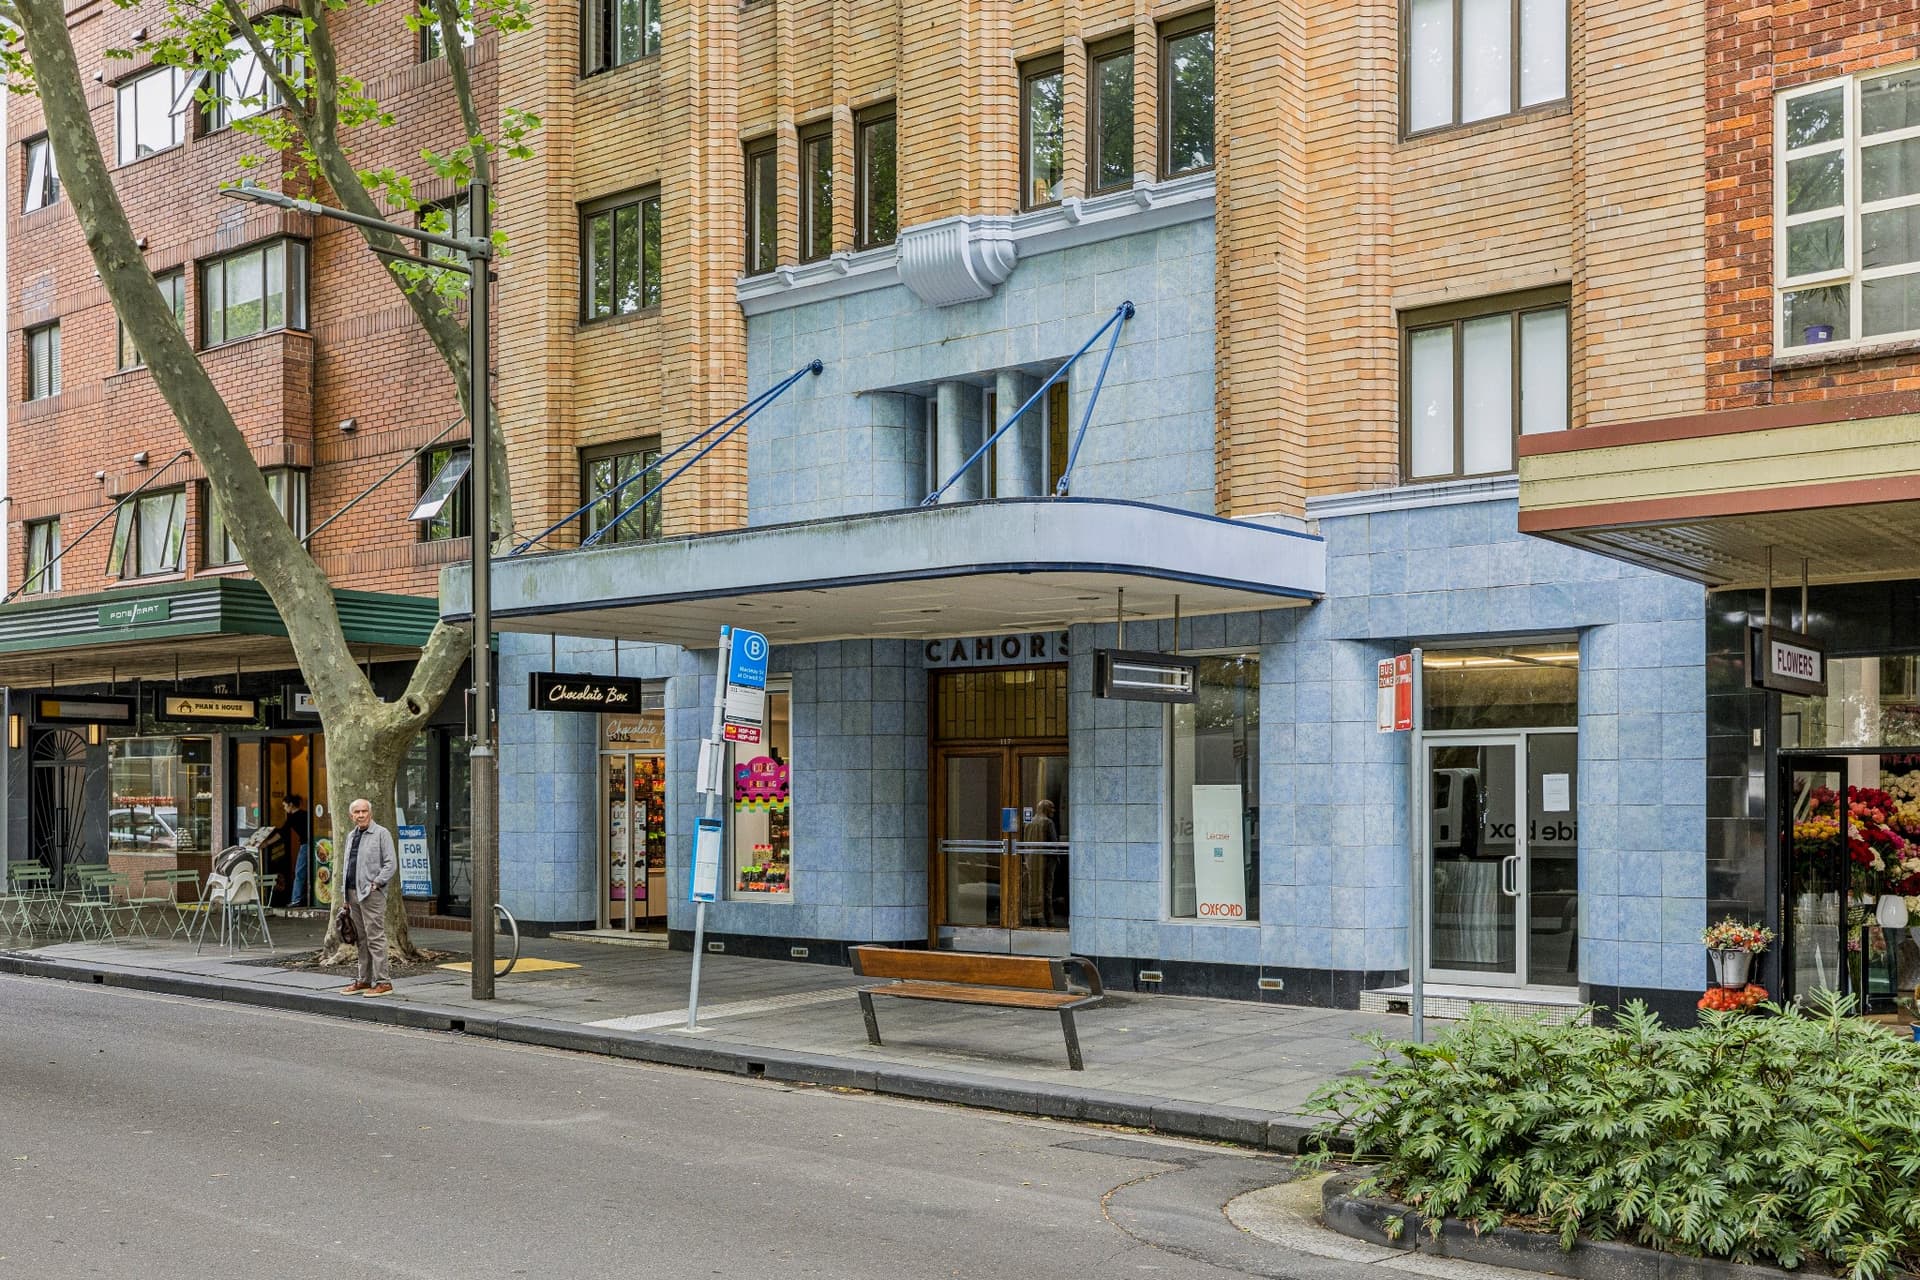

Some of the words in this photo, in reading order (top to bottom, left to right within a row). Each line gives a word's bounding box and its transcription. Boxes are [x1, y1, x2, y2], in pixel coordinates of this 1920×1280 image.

[750, 640, 760, 655] B
[924, 631, 1069, 662] CAHORS
[1380, 663, 1393, 675] BUS
[1777, 648, 1814, 677] FLOWERS
[1379, 677, 1393, 687] ZONE
[548, 684, 604, 701] Chocolate
[605, 687, 628, 703] Box
[221, 703, 243, 711] HOUSE
[606, 718, 657, 737] Chocolate
[404, 843, 422, 854] FOR
[401, 858, 428, 868] LEASE
[1199, 902, 1243, 917] OXFORD
